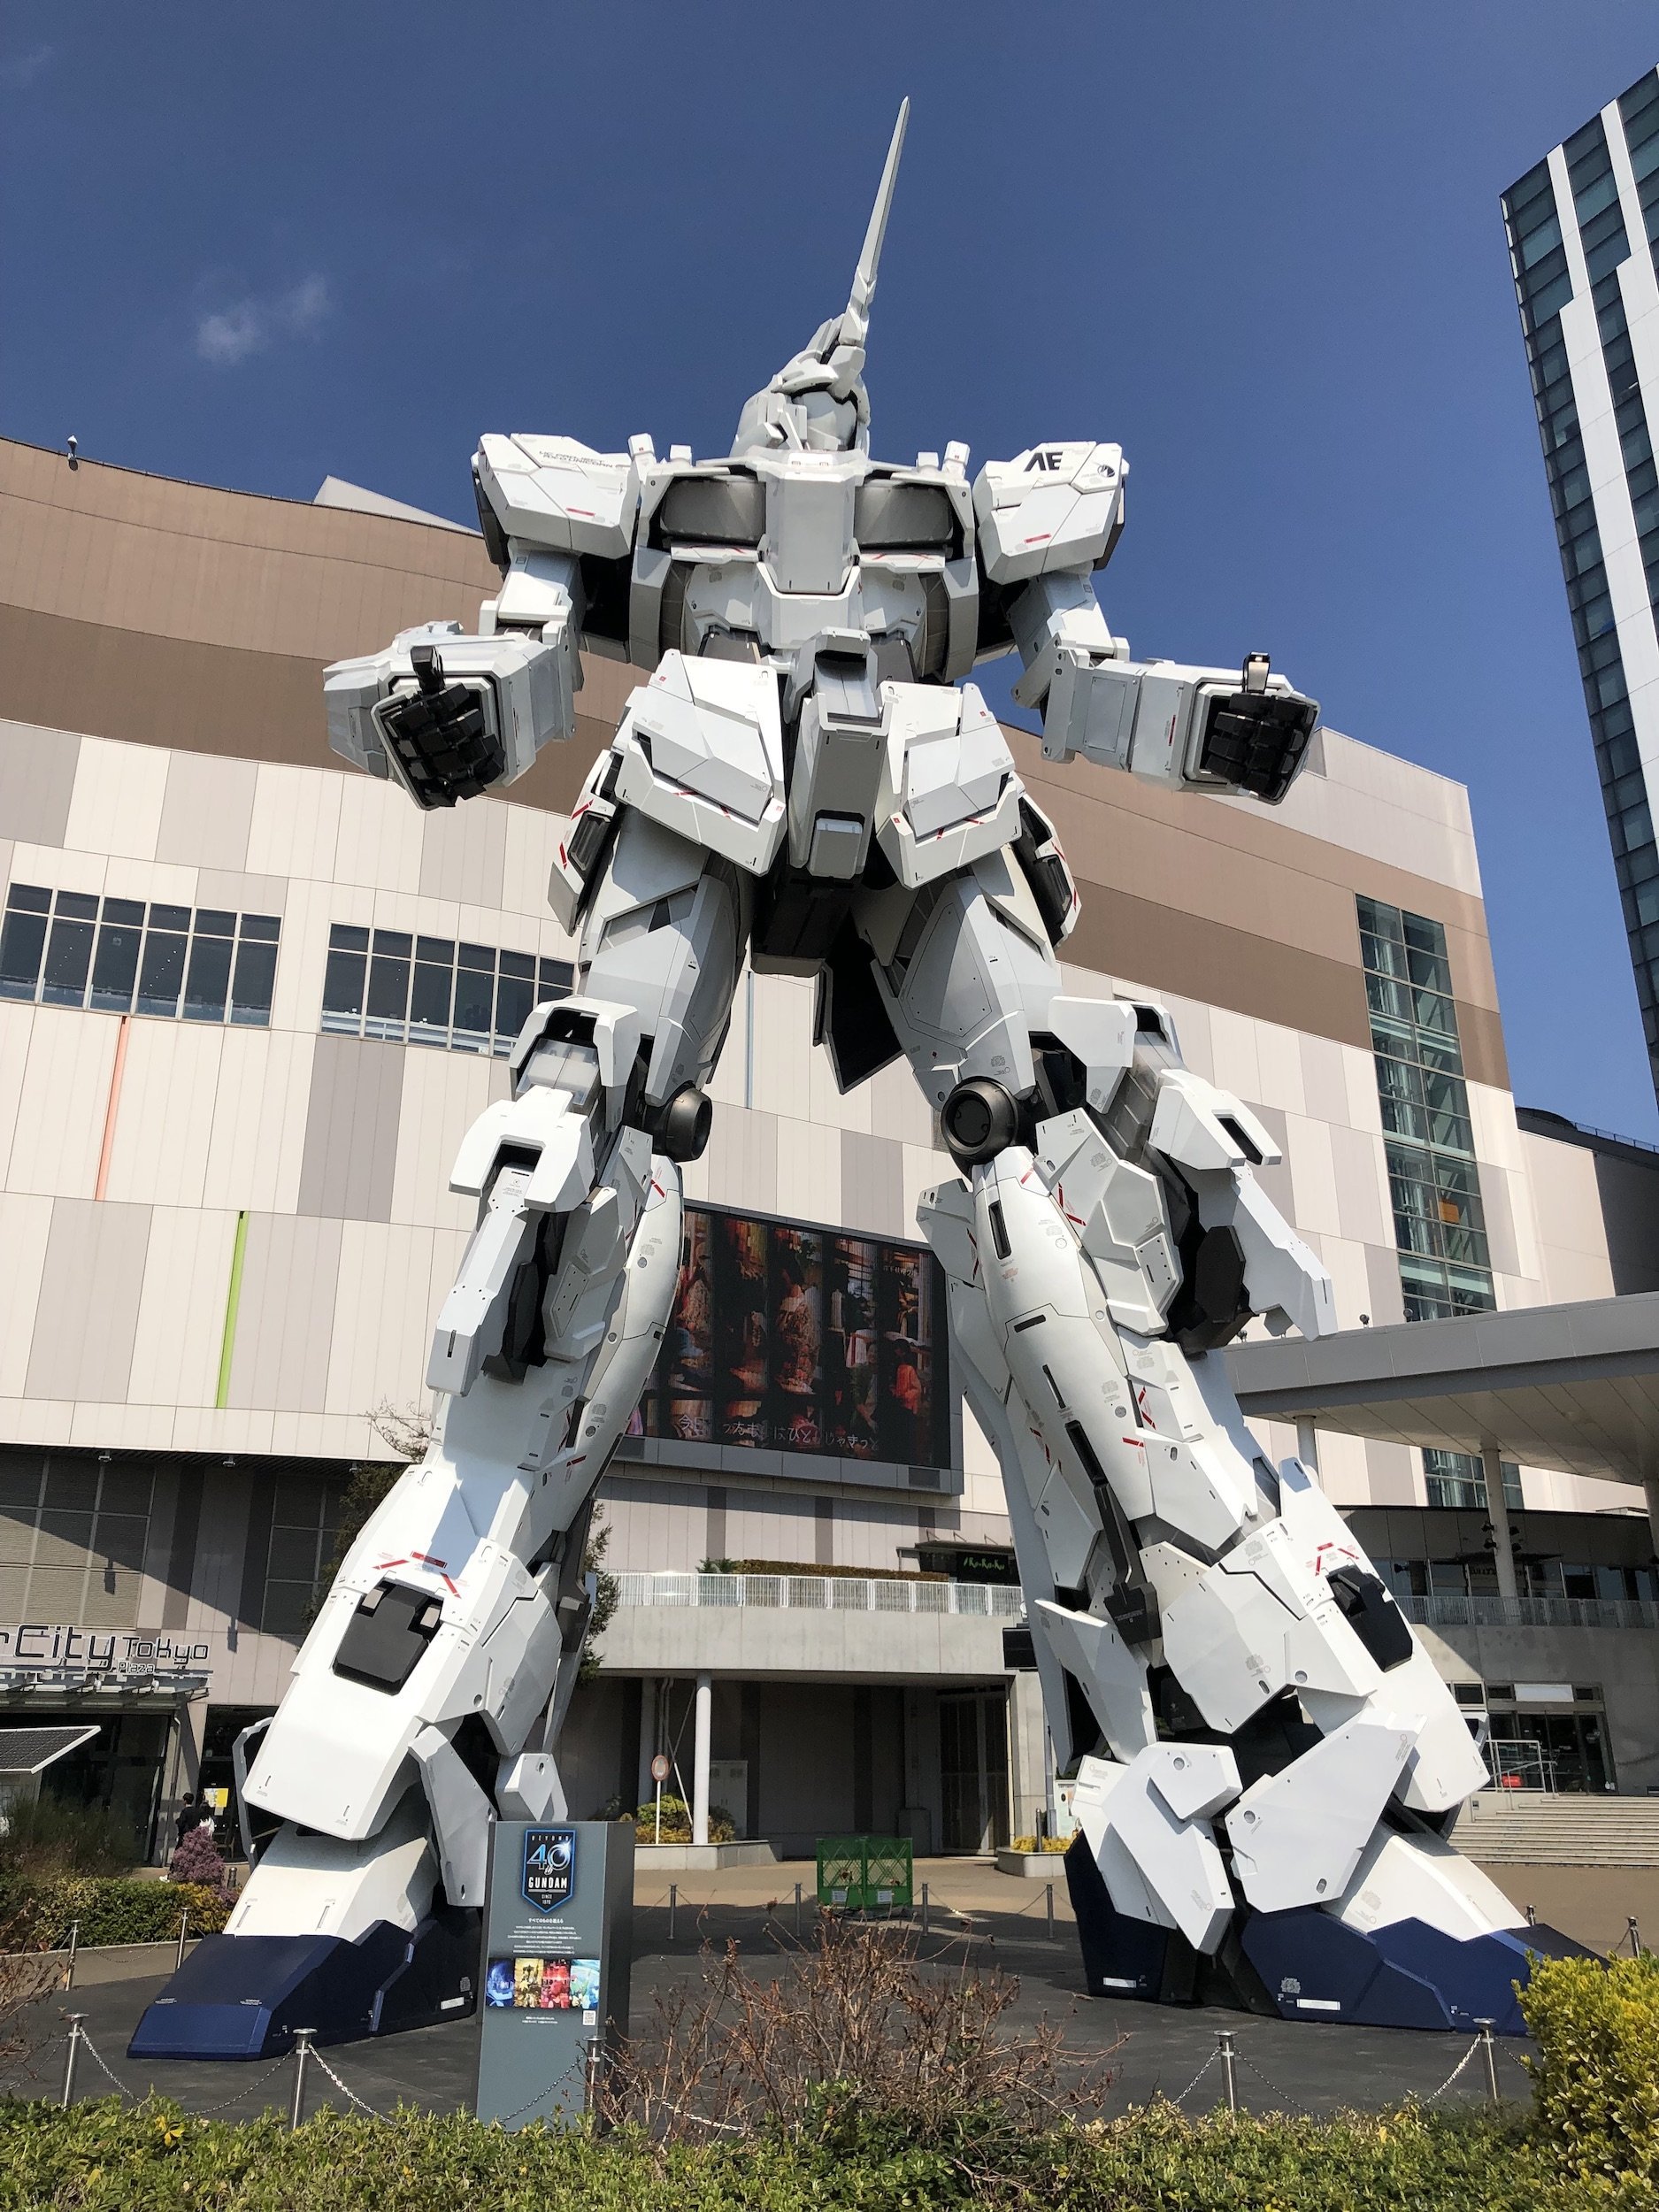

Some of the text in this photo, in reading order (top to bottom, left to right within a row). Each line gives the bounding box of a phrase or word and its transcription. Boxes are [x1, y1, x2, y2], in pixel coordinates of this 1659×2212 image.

[122, 1636, 209, 1665] Tokyo
[119, 1662, 155, 1674] Plaza
[528, 1877, 568, 1889] GUNDAM
